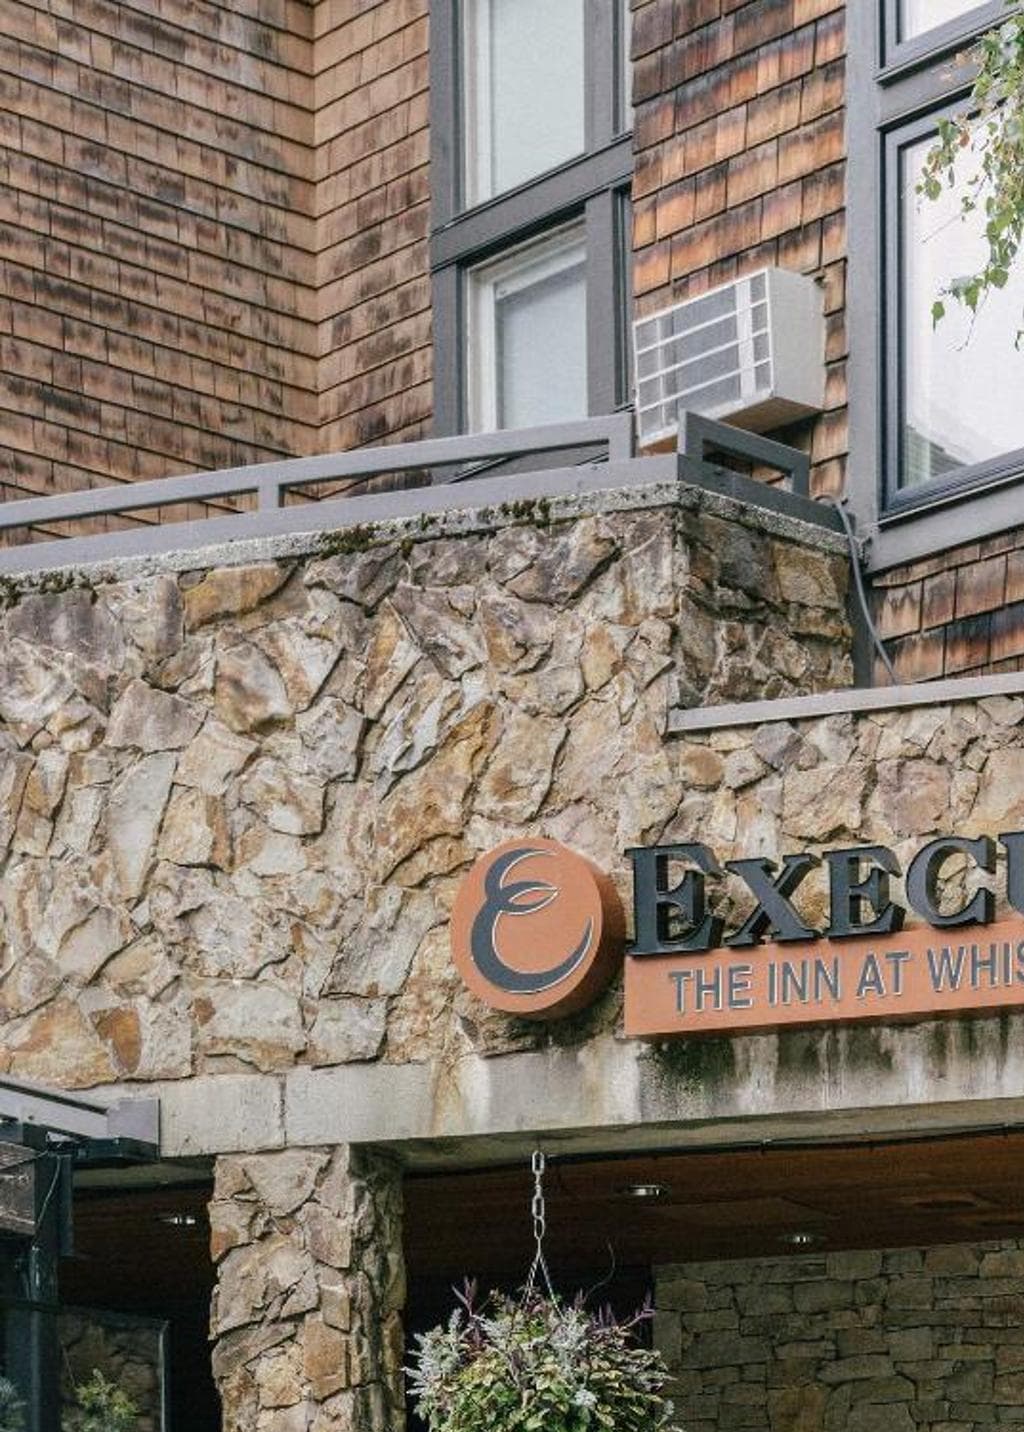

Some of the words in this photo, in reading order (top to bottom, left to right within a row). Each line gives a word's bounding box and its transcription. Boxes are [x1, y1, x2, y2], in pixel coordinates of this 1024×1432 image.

[669, 964, 753, 1015] THE
[767, 955, 842, 1005] INN
[856, 950, 910, 999] AT
